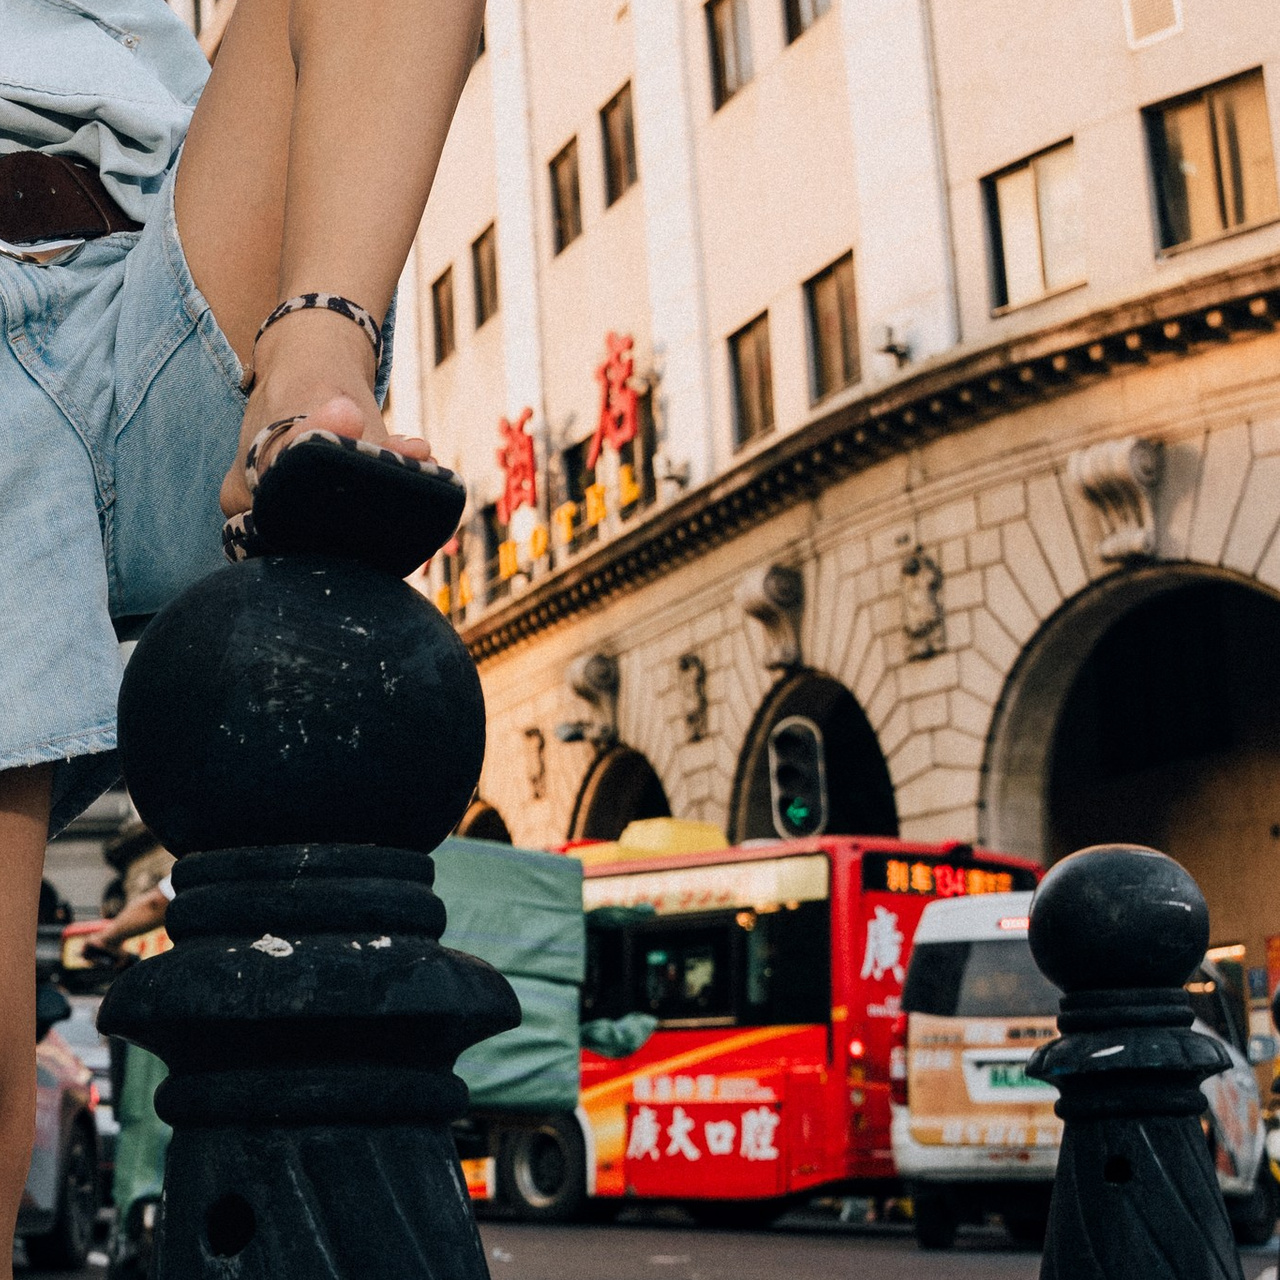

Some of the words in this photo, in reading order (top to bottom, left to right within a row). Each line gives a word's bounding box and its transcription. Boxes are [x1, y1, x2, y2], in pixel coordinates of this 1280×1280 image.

[498, 464, 640, 580] HOTEL
[626, 1105, 781, 1162] 廣大口腔
